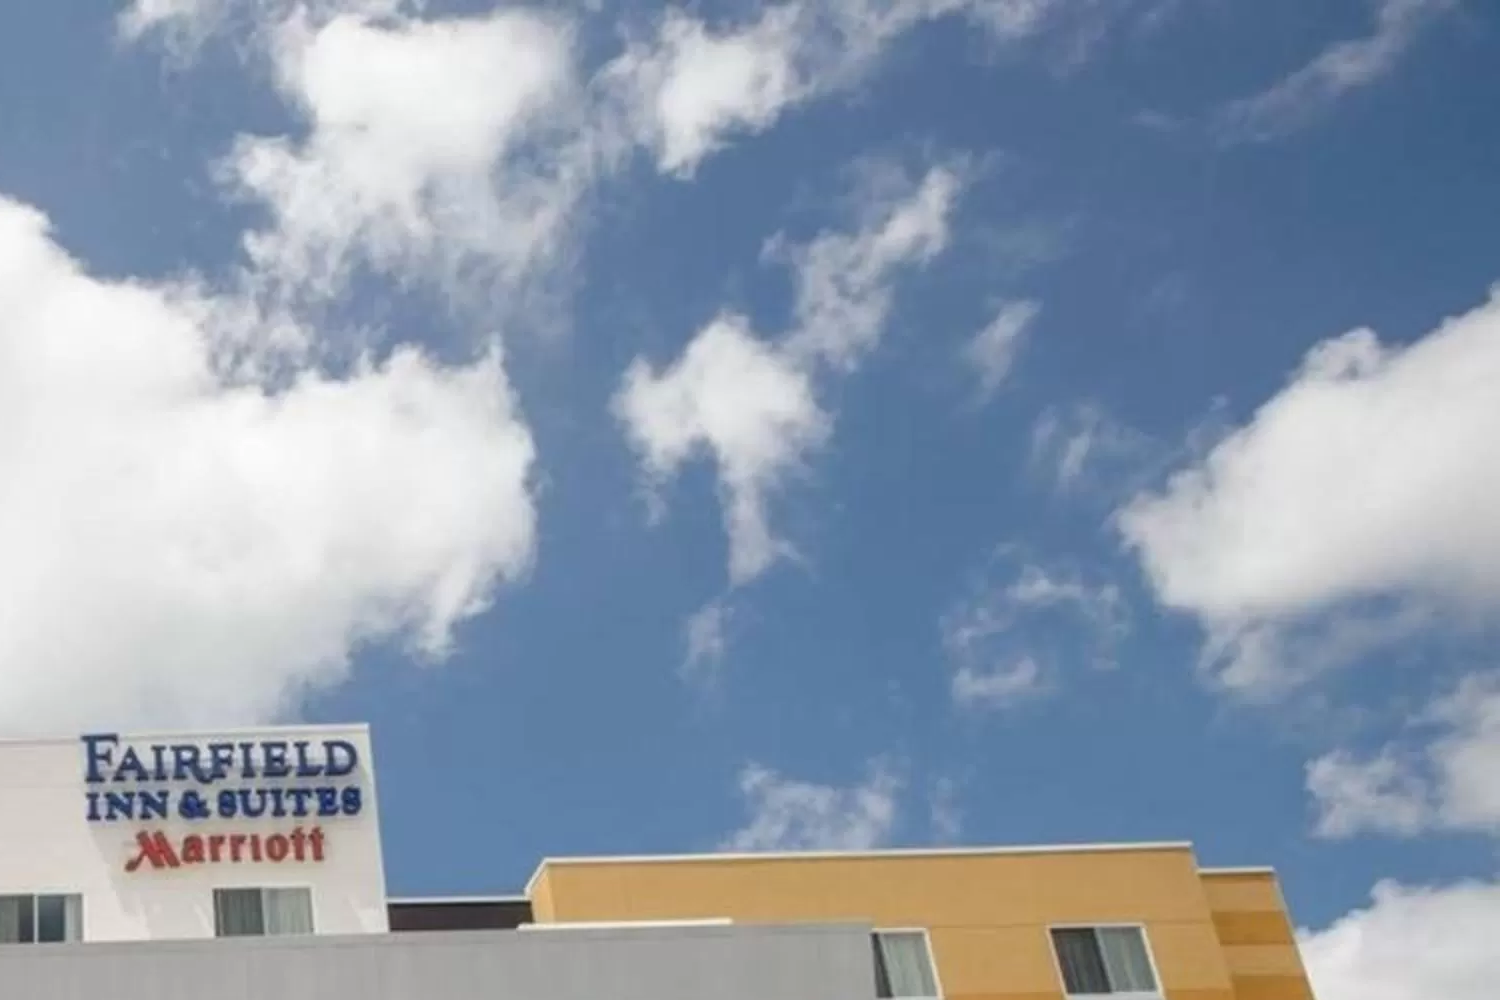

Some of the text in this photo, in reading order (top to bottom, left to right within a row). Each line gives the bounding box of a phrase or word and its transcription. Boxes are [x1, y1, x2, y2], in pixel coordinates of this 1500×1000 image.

[80, 733, 358, 784] FAIRFIELD
[85, 786, 362, 820] INN & SUITES
[125, 826, 325, 872] Marriott
